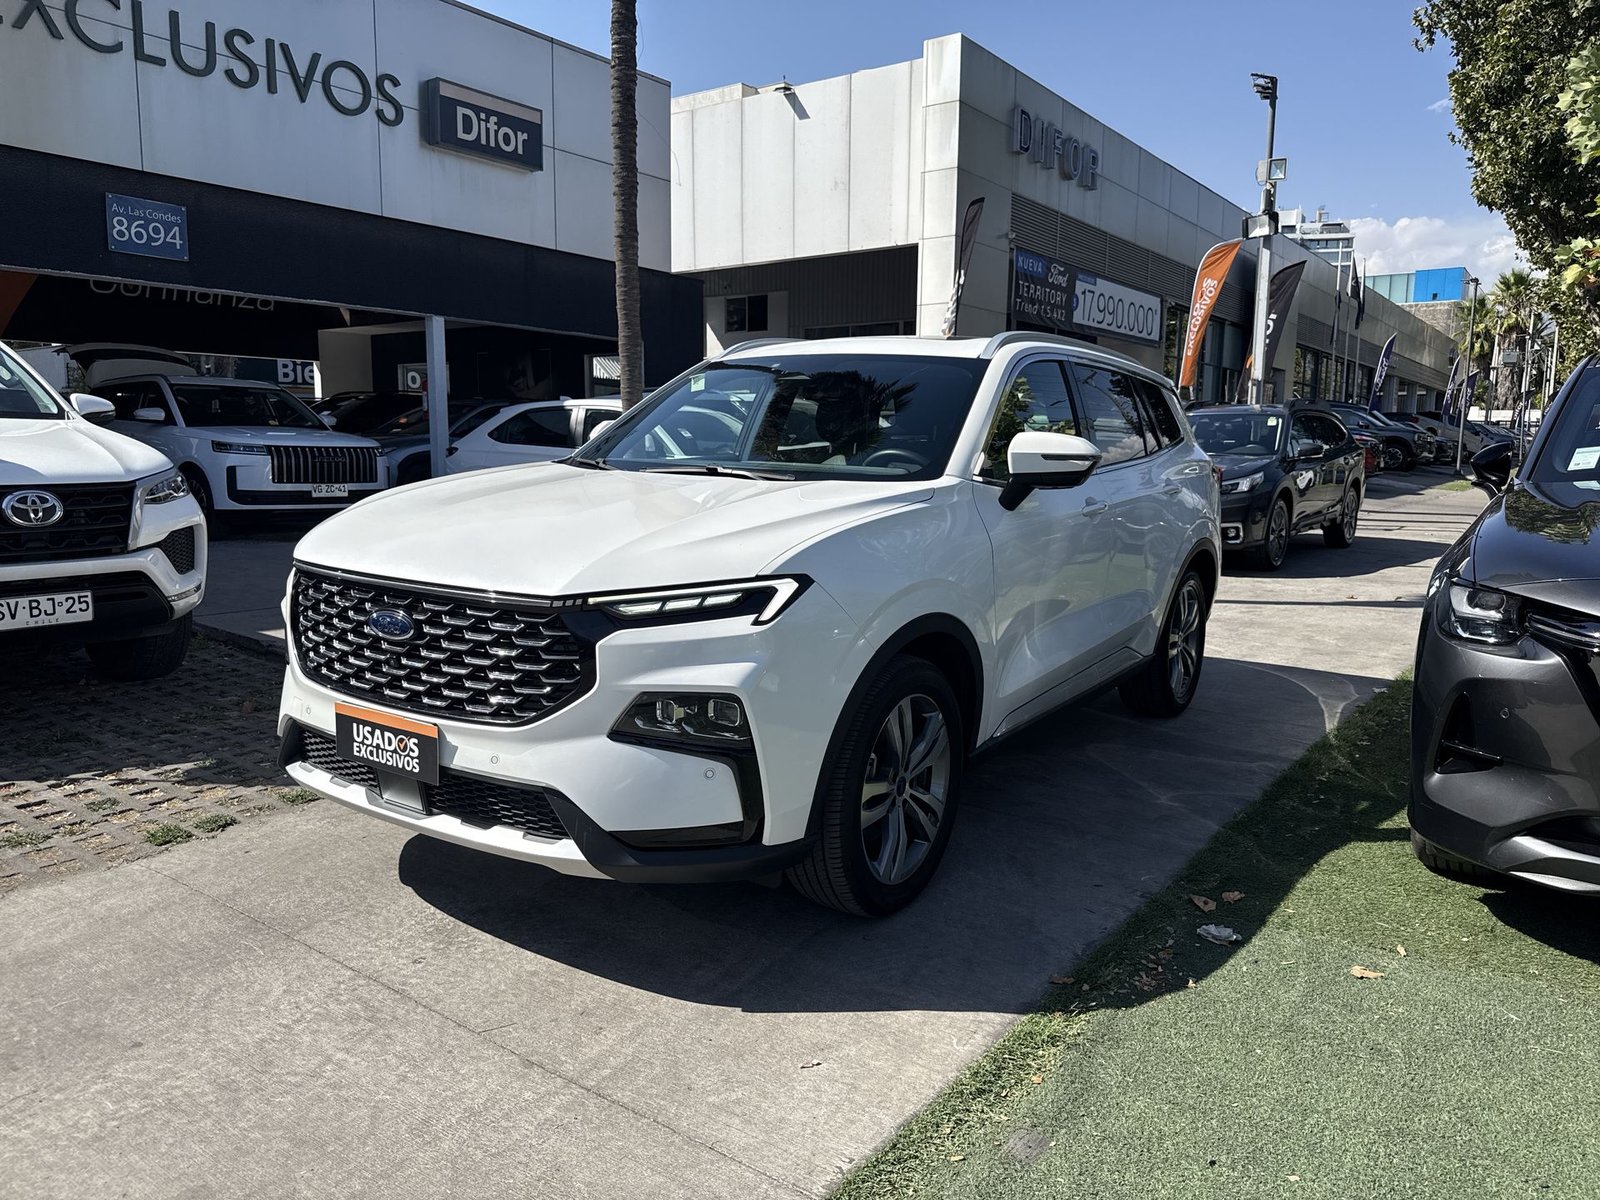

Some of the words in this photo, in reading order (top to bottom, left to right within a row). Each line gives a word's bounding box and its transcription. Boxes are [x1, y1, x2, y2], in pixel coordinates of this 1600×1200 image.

[456, 105, 528, 155] Difor
[1014, 107, 1099, 190] DIFOR
[111, 203, 127, 214] Av.
[128, 206, 144, 217] Las
[146, 209, 182, 224] Condes
[112, 216, 184, 250] 8694
[1017, 255, 1043, 274] NUEVA
[1047, 263, 1070, 288] Ford
[1015, 298, 1039, 315] Trend
[1018, 280, 1068, 307] TERRITORY
[25, 617, 60, 626] CHILE
[352, 722, 420, 757] USADOS
[353, 741, 420, 773] EXCLUSIVOS
